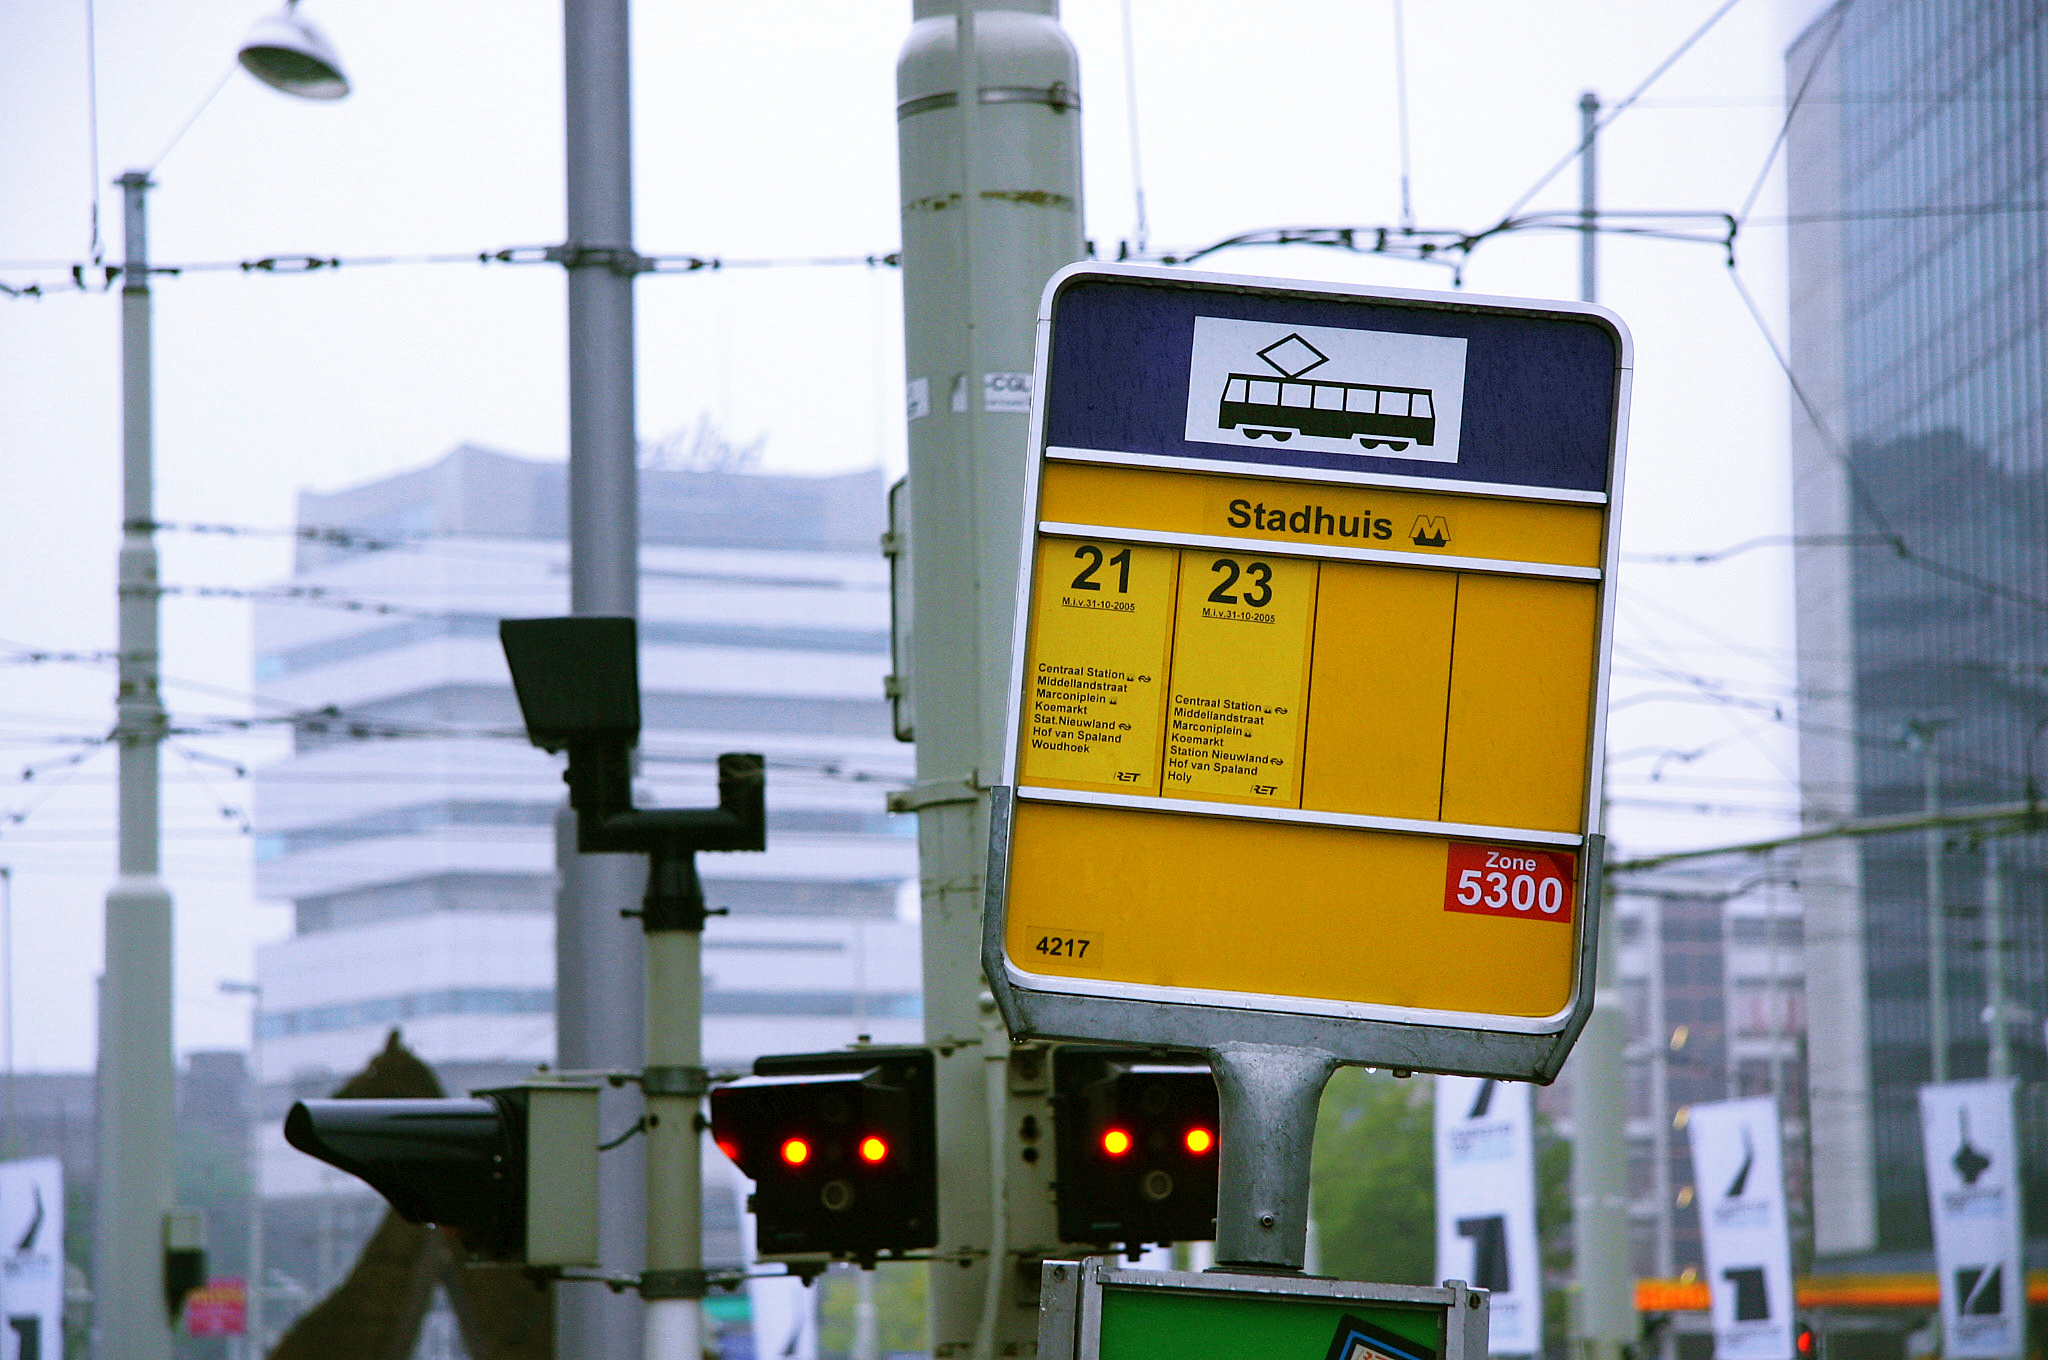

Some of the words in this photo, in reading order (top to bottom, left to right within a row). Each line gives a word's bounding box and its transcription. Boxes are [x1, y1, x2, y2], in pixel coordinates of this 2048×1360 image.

[1227, 499, 1393, 540] Stadhuis
[1071, 545, 1131, 594] 21
[1207, 558, 1273, 608] 23
[1038, 663, 1083, 676] Centraal
[1087, 667, 1125, 680] Station
[1037, 676, 1128, 693] Middellandstraat
[1036, 688, 1106, 703] Marconiplein
[1175, 694, 1220, 708] Centraal
[1223, 699, 1262, 712] Station
[1035, 701, 1088, 715] Koemarkt
[1174, 707, 1264, 725] Middellandstraat
[1033, 727, 1052, 737] Hof
[1055, 730, 1074, 739] van
[1077, 731, 1122, 743] Spaland
[1173, 720, 1242, 736] Marconiplein
[1032, 739, 1090, 753] Woudhoek
[1171, 733, 1224, 747] Koemarkt
[1170, 745, 1208, 758] Station
[1212, 750, 1269, 764] Nieuwland
[1169, 758, 1188, 769] Hof
[1191, 762, 1210, 771] van
[1213, 763, 1258, 776] Spaland
[1168, 771, 1192, 784] Holy
[1485, 851, 1536, 871] Zone
[1457, 869, 1563, 914] 5300
[1036, 936, 1090, 958] 4217
